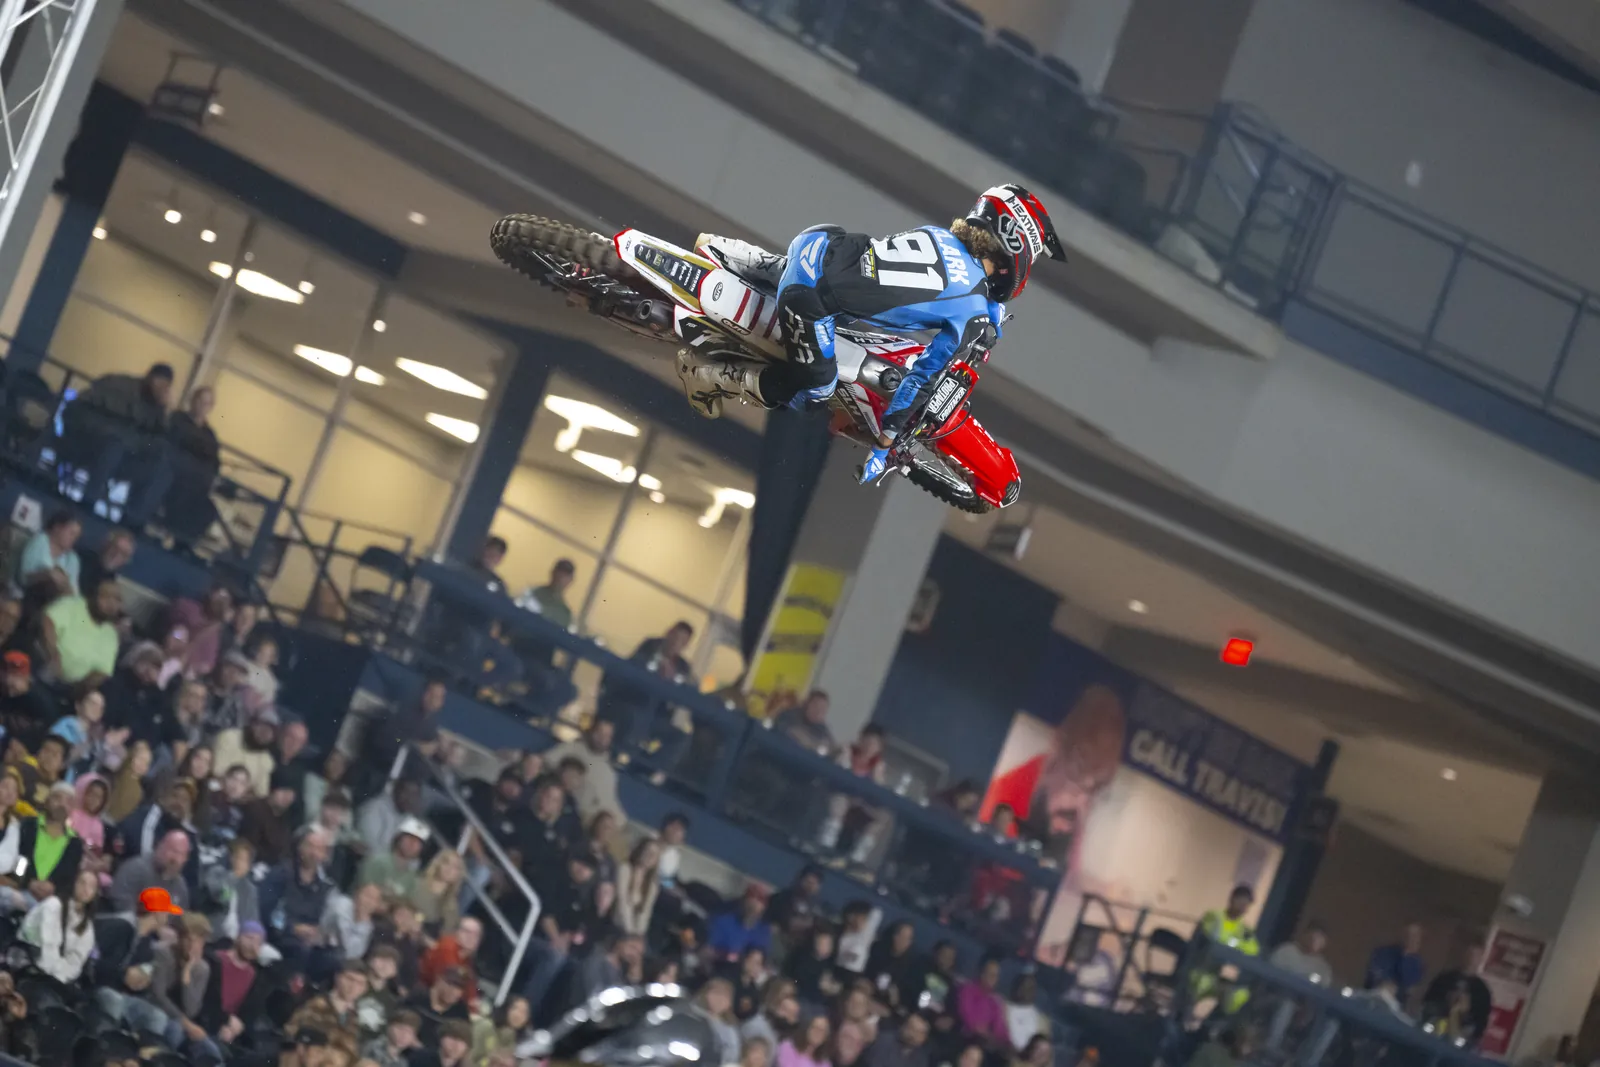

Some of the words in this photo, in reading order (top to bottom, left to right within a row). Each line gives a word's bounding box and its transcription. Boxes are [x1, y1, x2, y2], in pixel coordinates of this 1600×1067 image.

[870, 230, 944, 291] 91
[928, 378, 956, 412] PROTAPER
[1130, 729, 1189, 786] CALL
